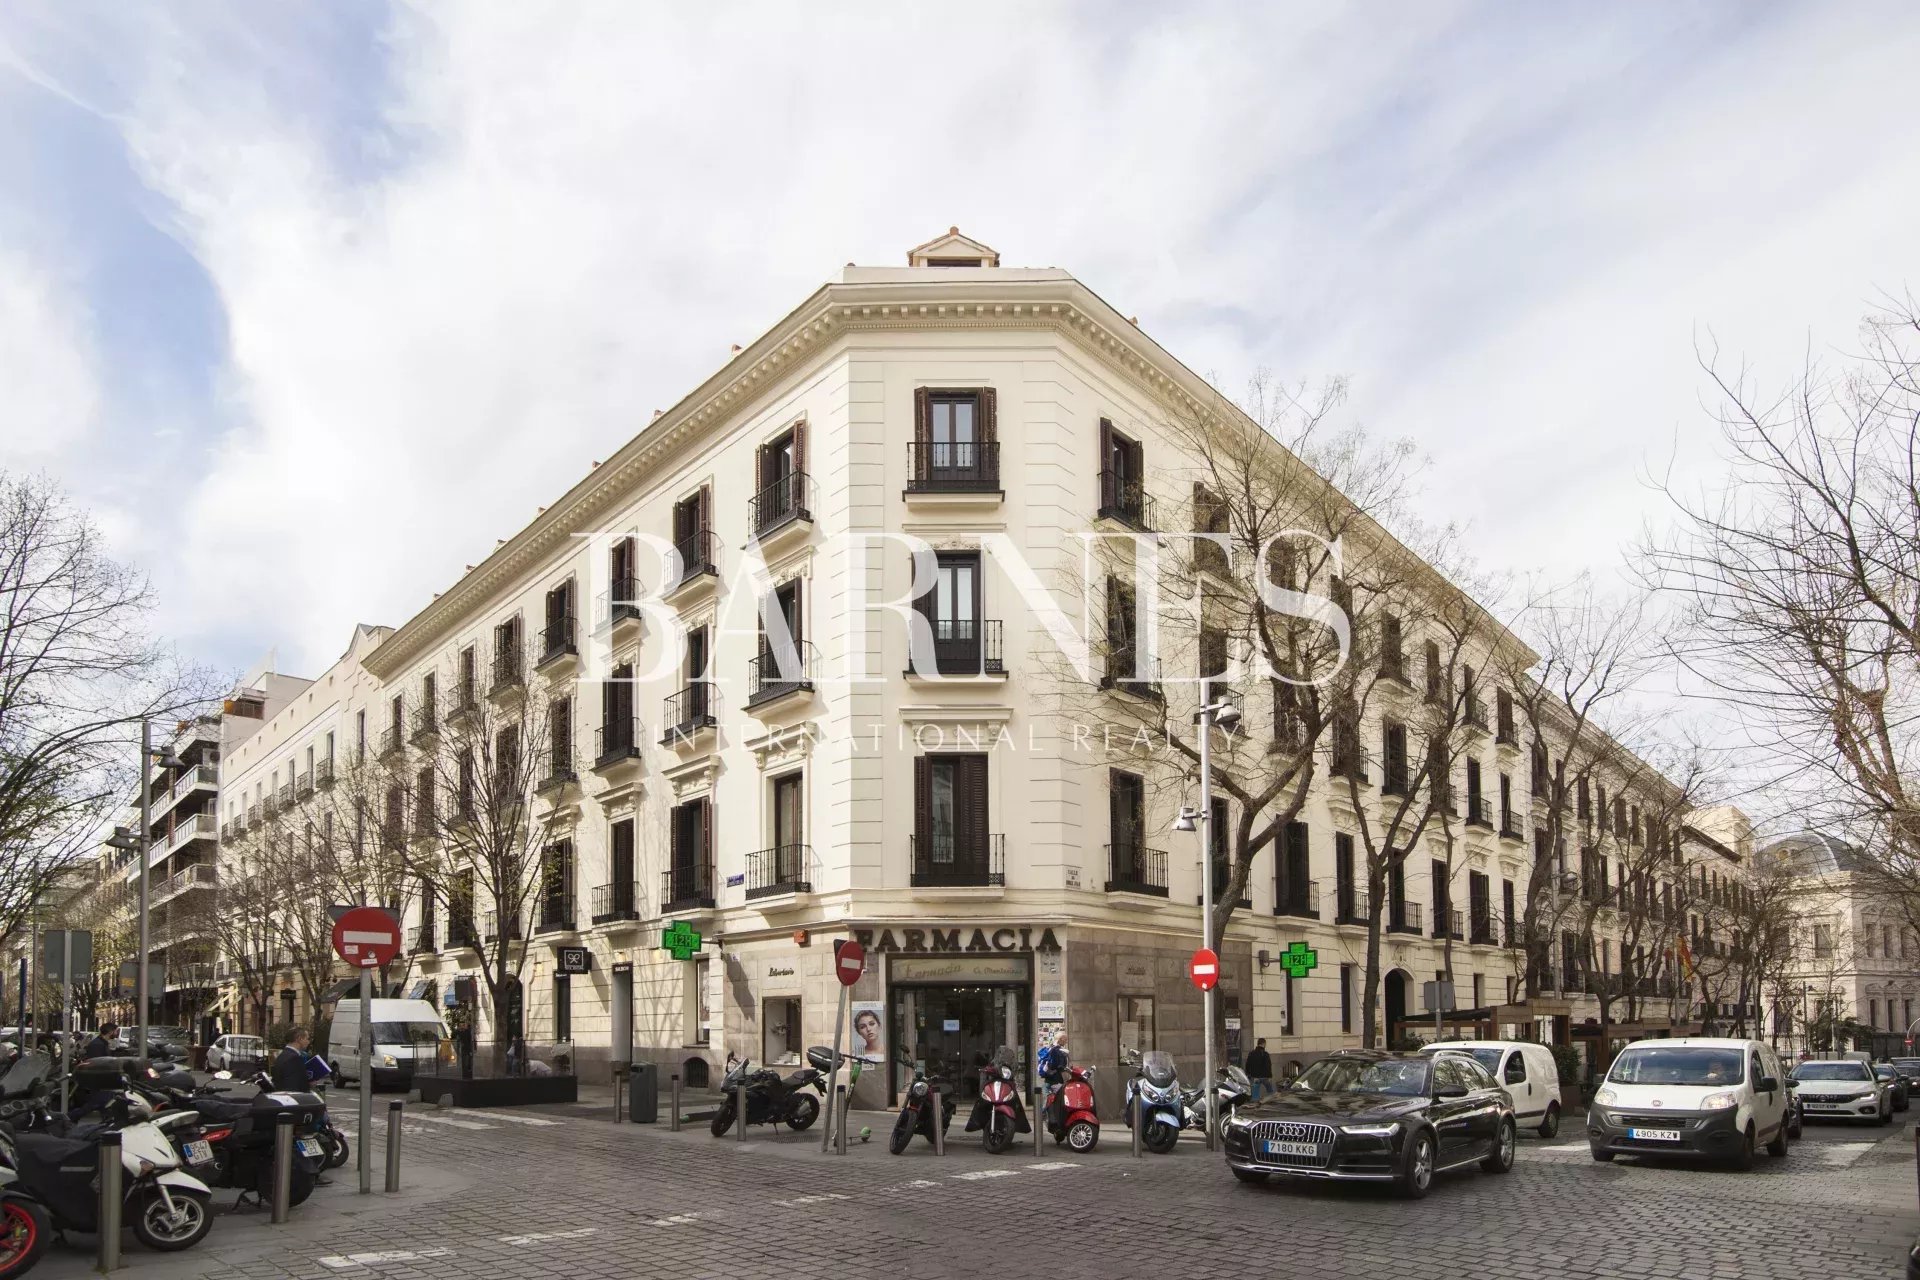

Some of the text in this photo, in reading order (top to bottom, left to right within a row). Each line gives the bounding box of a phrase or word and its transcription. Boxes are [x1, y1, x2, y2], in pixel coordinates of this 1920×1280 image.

[673, 934, 692, 948] 12H
[854, 928, 1062, 952] FARMACIA
[1289, 954, 1307, 966] 12H
[1635, 1130, 1658, 1138] 4905
[1269, 1142, 1315, 1155] 7180 KKG
